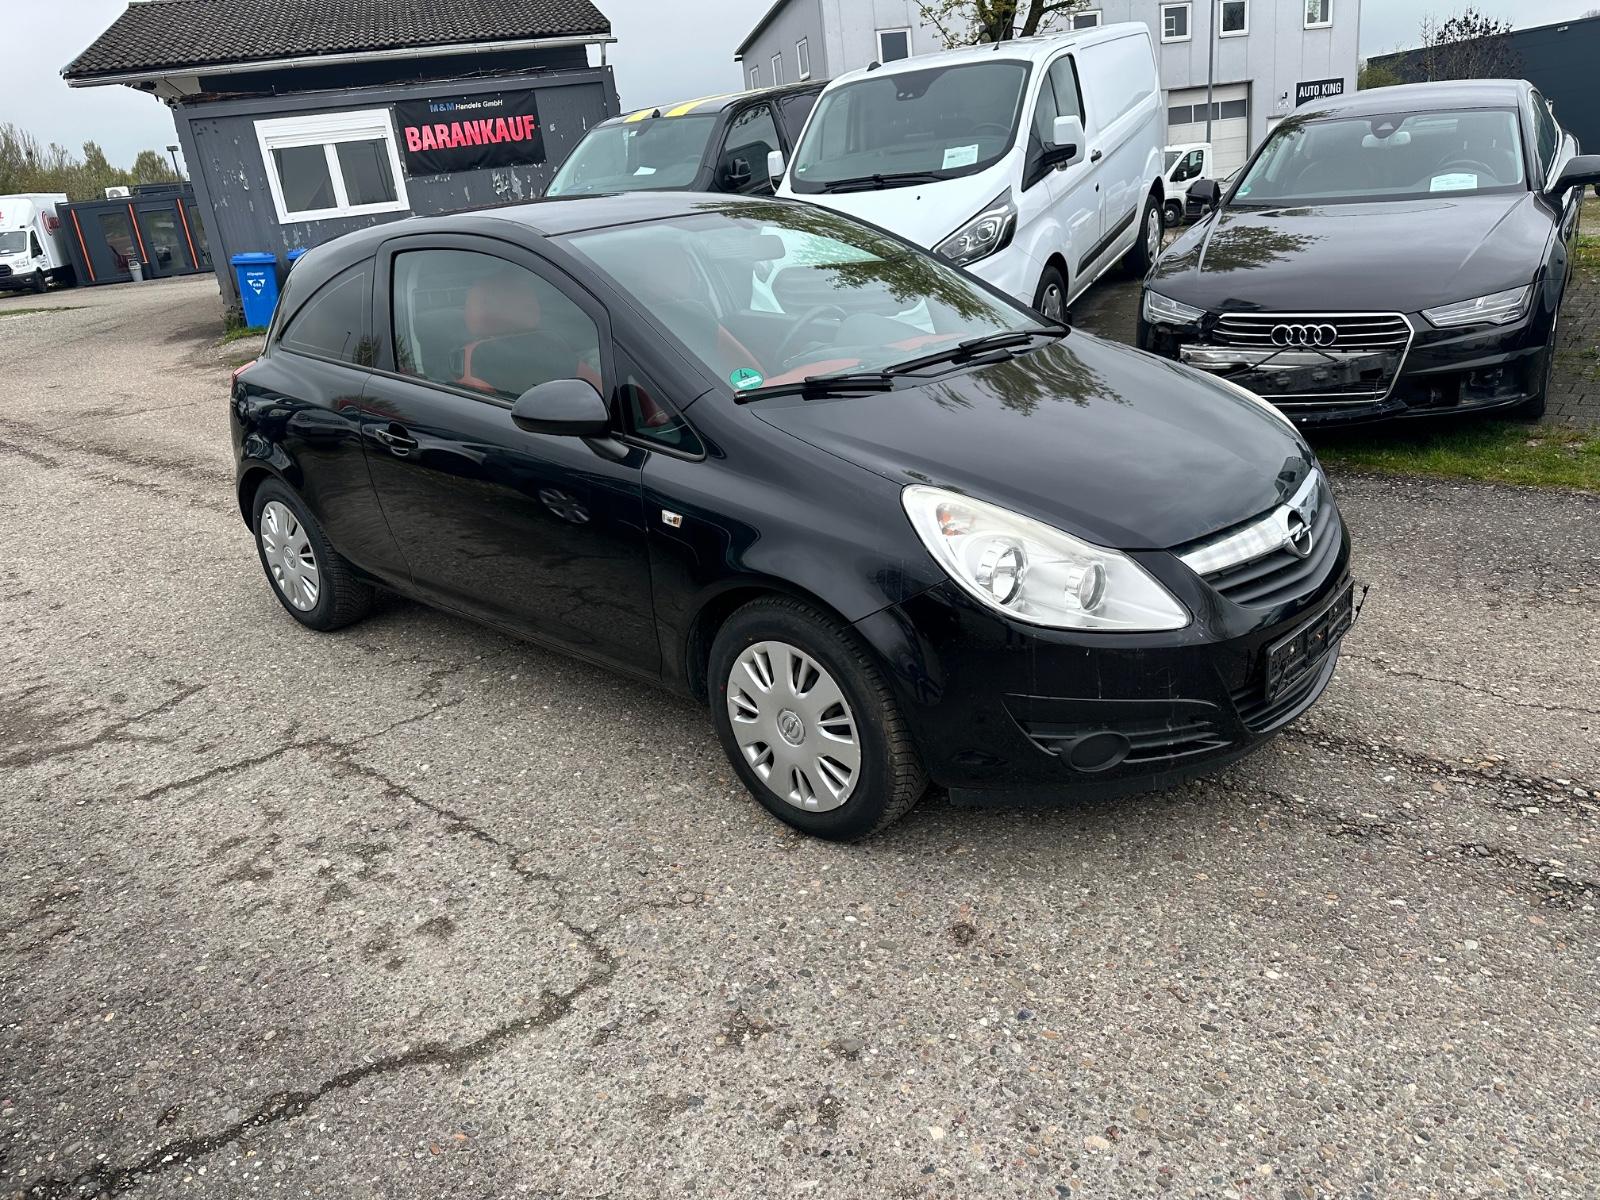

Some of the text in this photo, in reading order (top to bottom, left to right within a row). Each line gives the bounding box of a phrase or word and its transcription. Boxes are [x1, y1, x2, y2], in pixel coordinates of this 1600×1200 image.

[1298, 82, 1342, 98] AUTO KING
[429, 99, 503, 113] M&M Handels GmbH
[404, 114, 536, 152] BARANKAUF
